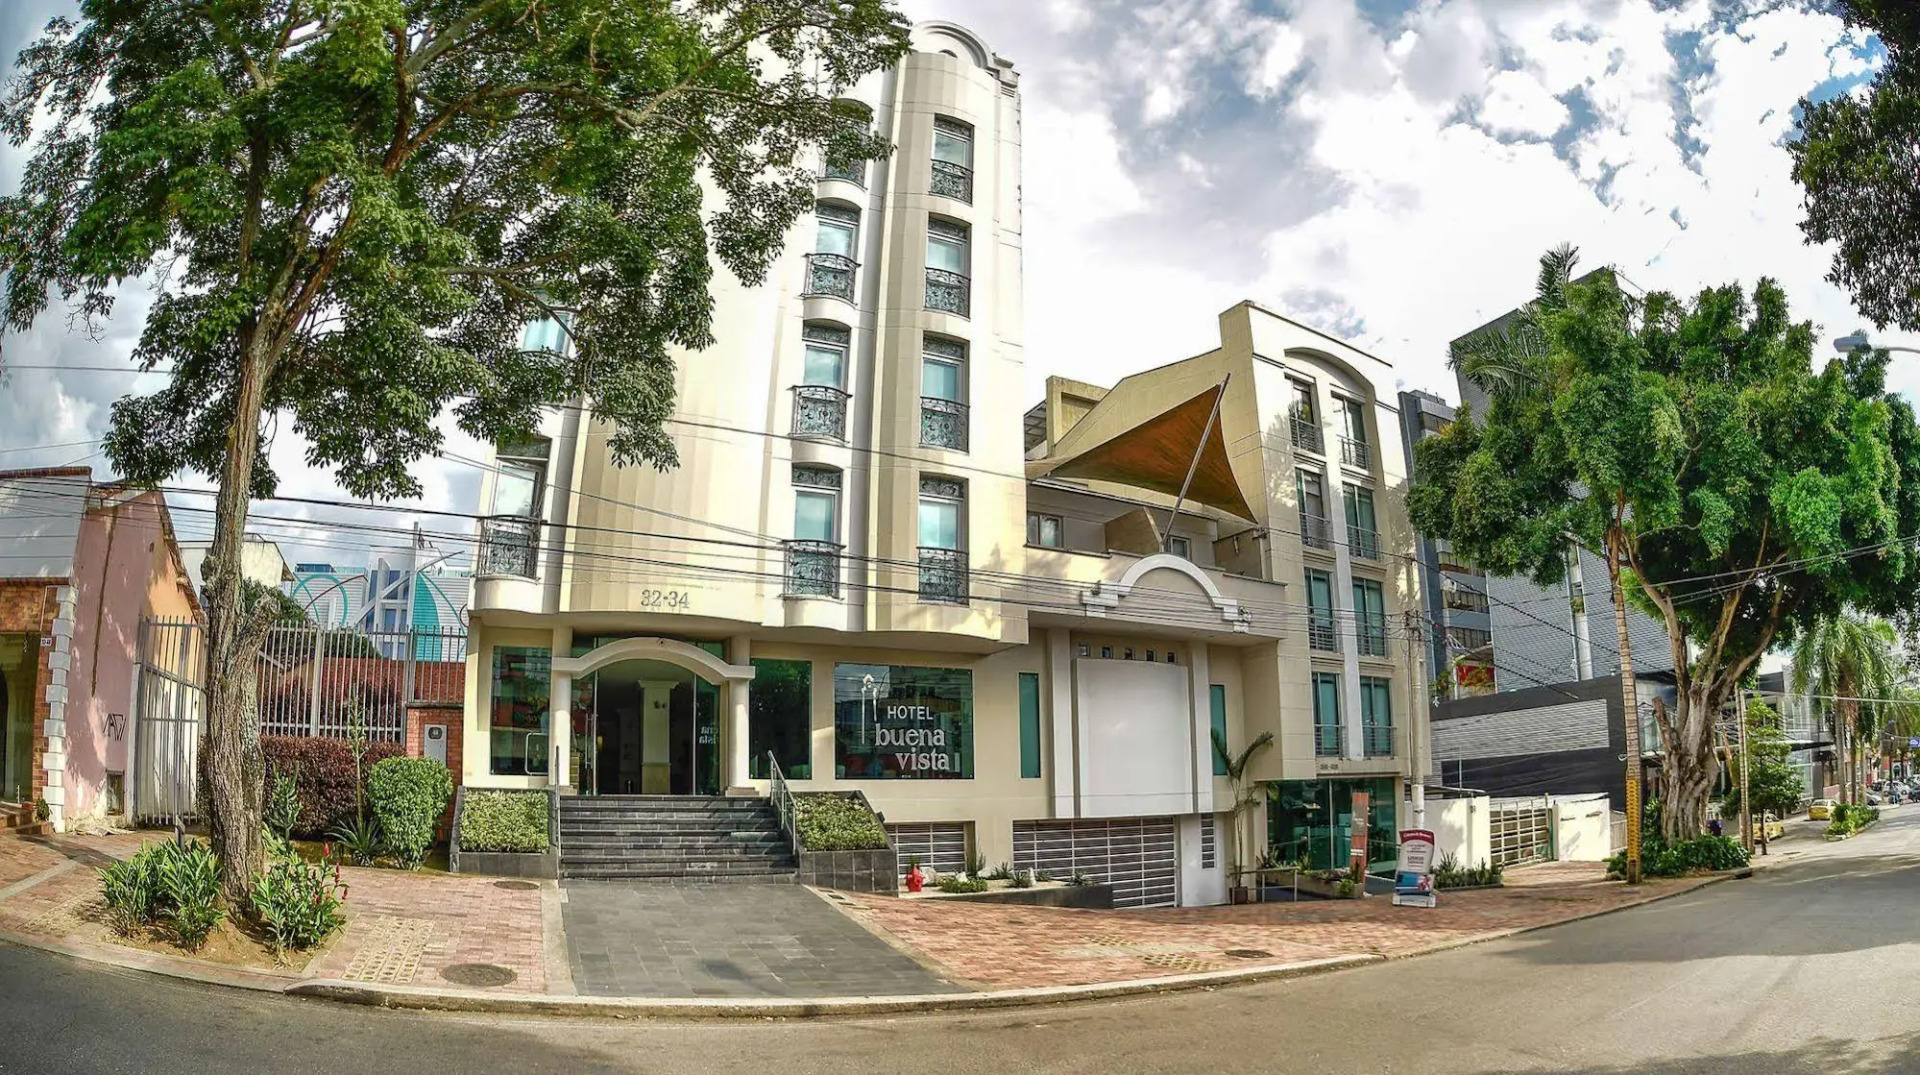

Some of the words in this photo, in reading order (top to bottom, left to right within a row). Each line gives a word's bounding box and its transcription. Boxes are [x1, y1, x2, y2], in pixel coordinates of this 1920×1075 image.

[641, 589, 690, 609] 32-34
[887, 705, 934, 720] HOTEL
[874, 722, 946, 746] buena
[895, 747, 950, 771] vista
